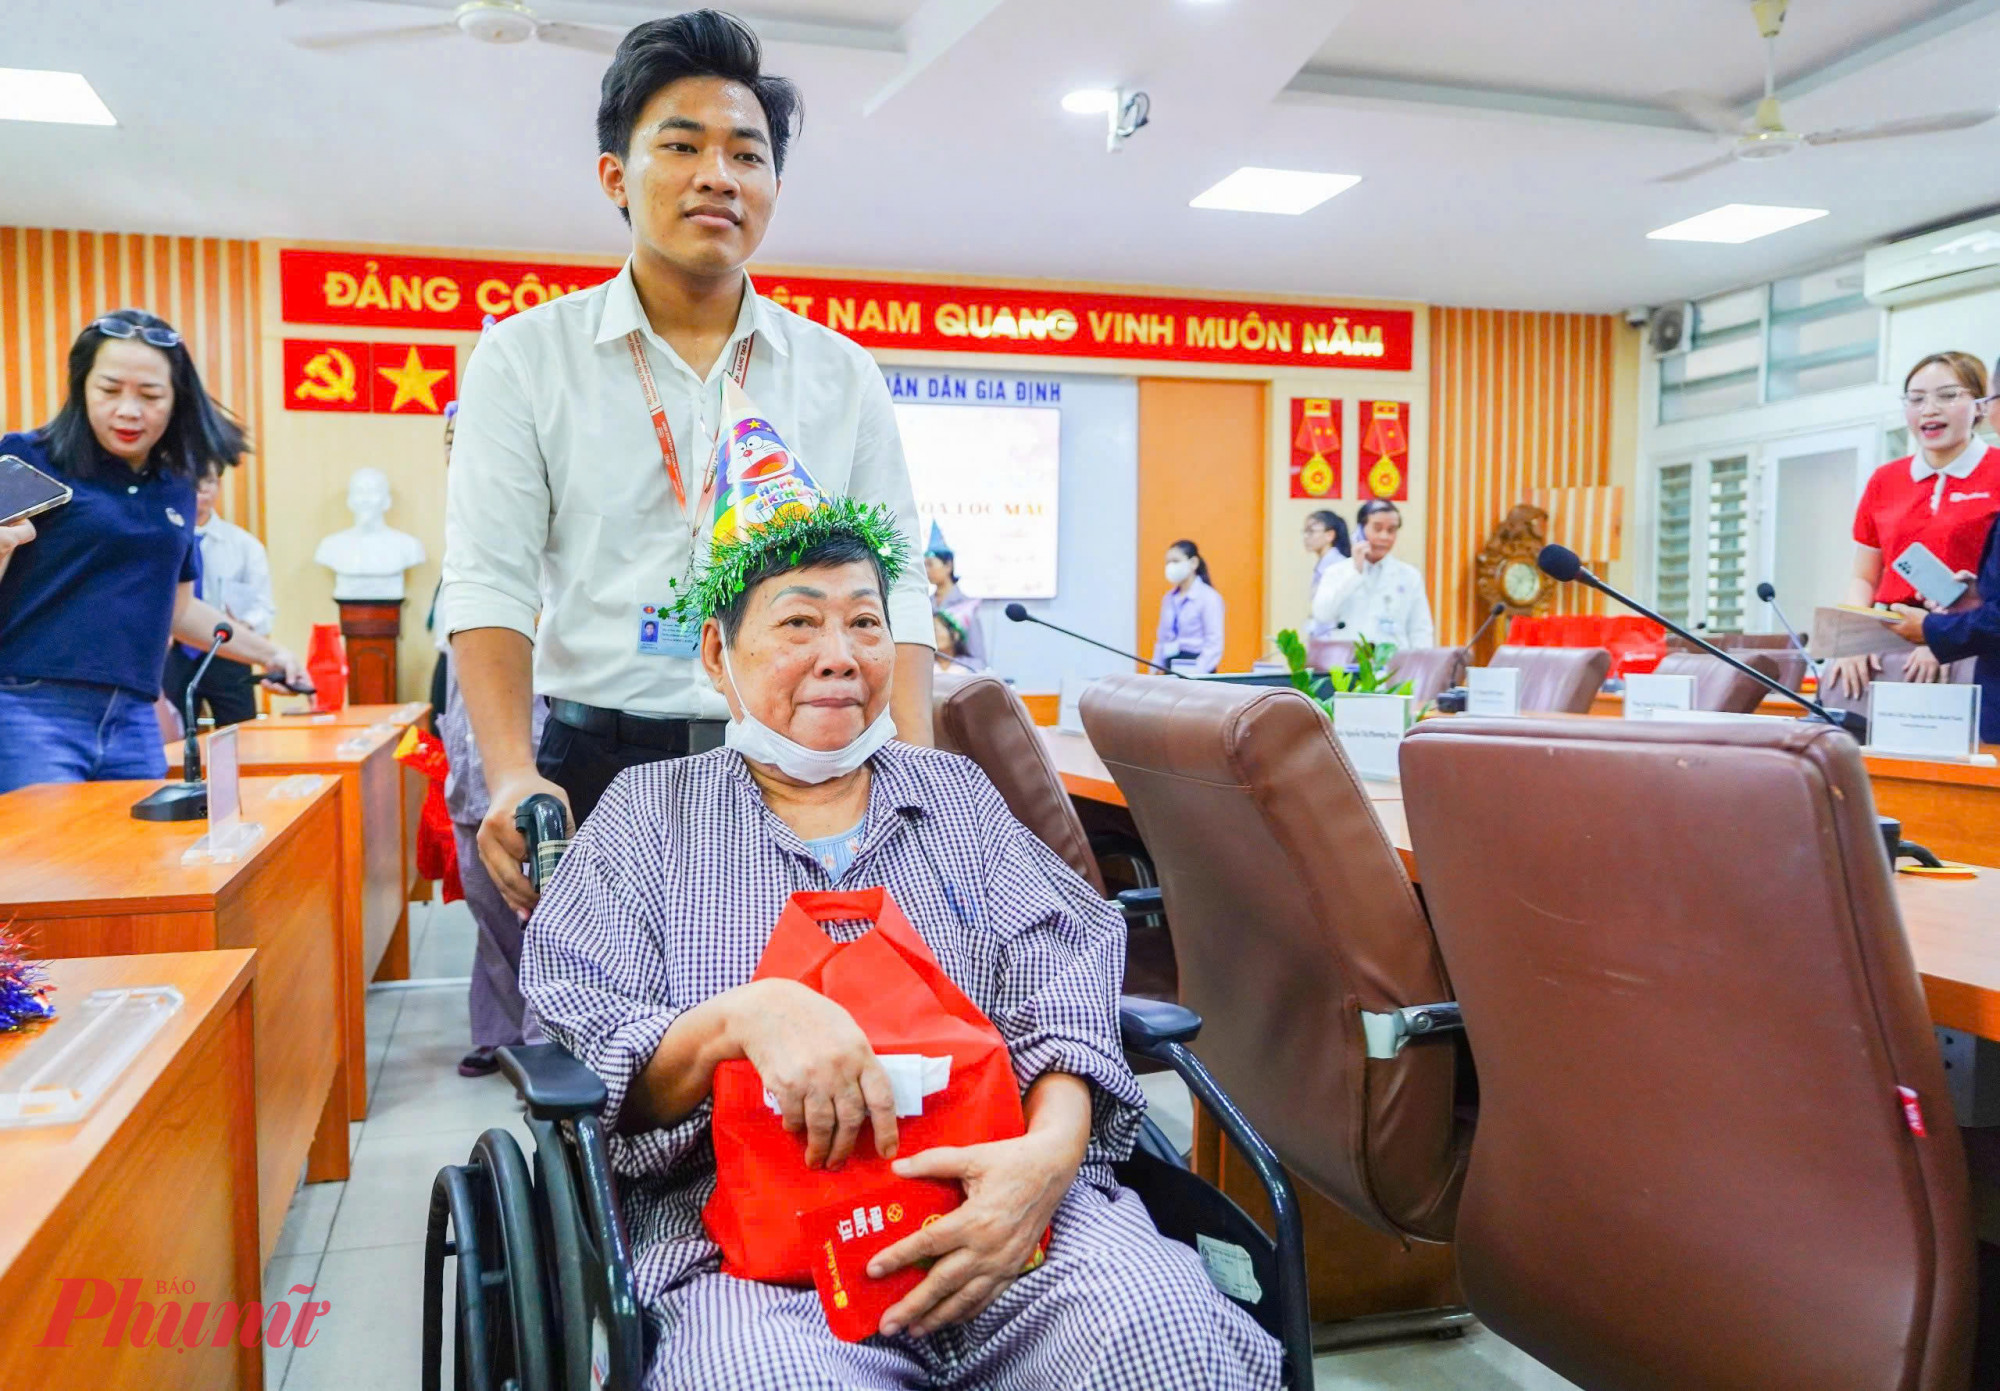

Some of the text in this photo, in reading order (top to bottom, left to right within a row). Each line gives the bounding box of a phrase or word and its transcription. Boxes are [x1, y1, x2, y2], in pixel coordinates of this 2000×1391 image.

[323, 260, 597, 315] ĐẢNG CÔ
[828, 298, 921, 334] NAM
[935, 302, 1078, 341] QUANG
[1087, 310, 1174, 346] VINH
[1186, 311, 1292, 353] MUÔN
[1301, 317, 1385, 356] NĂM
[886, 373, 1061, 405] ÂN DÂN GIA ĐỊNH
